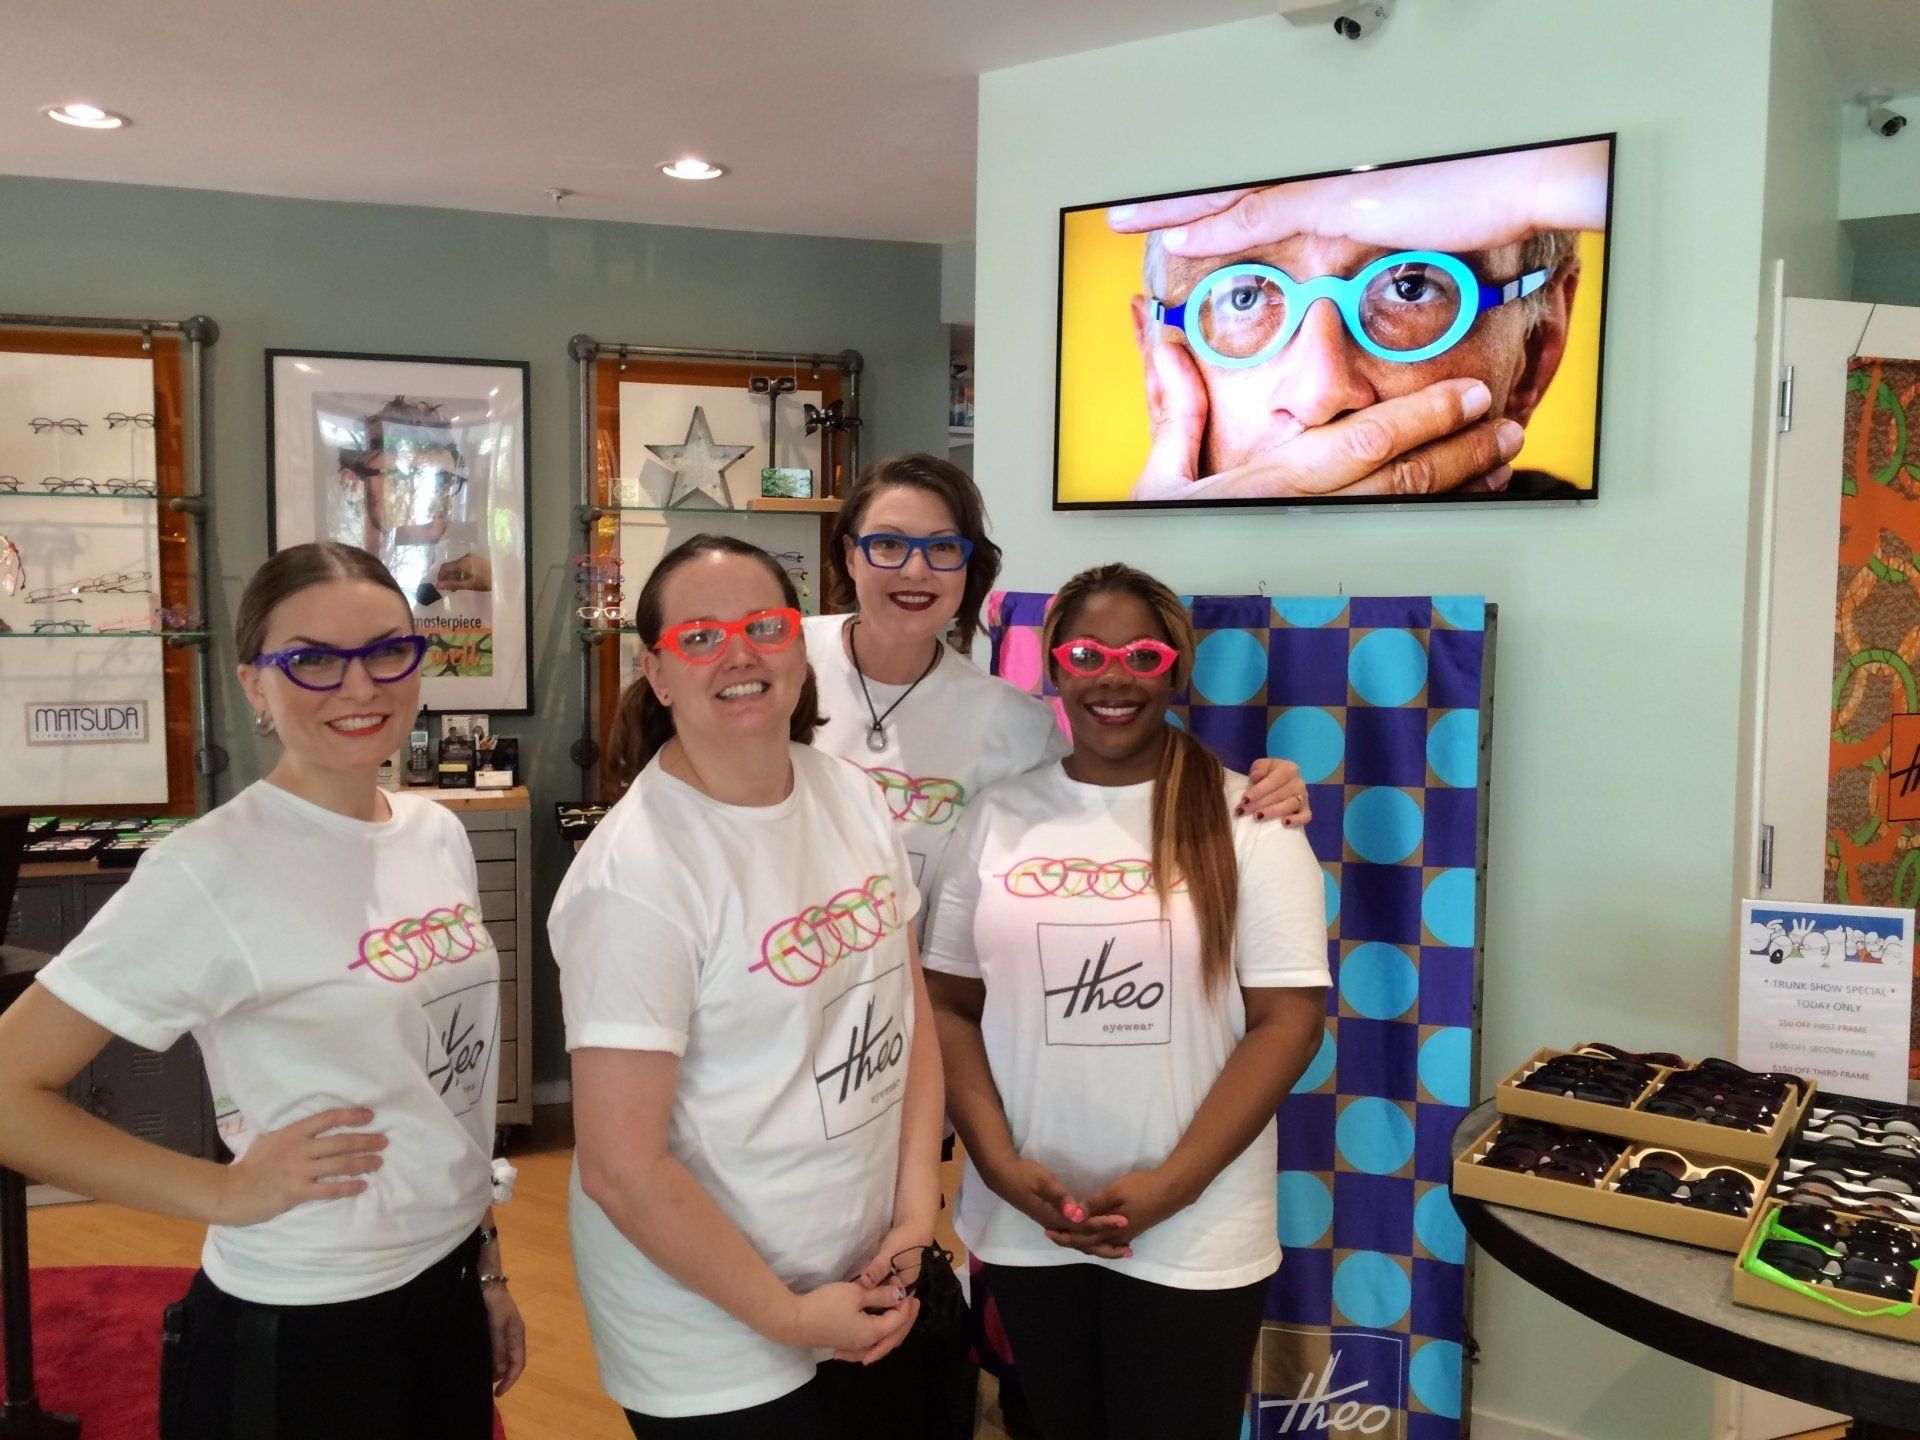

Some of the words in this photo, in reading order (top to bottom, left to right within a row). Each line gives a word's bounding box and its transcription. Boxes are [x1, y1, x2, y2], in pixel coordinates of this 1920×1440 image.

[413, 615, 482, 631] masterpiece
[35, 707, 139, 732] MATSUDA
[1045, 936, 1164, 1019] theo
[1772, 979, 1807, 991] TRUNK
[1810, 982, 1843, 994] SHOW
[1846, 985, 1888, 997] SPECIAL
[1796, 1000, 1830, 1011] TODAY
[1834, 1002, 1862, 1013] ONLY
[1102, 1022, 1154, 1034] eyewear
[1795, 1020, 1811, 1029] OFF
[1813, 1022, 1836, 1031] FIRST
[1838, 1024, 1869, 1034] FRAME
[816, 994, 903, 1104] theo
[1845, 1048, 1876, 1058] FRAME
[1772, 1064, 1793, 1073] $150
[1795, 1066, 1811, 1075] OFF
[1812, 1068, 1839, 1078] THIRD
[1840, 1071, 1871, 1081] FRAME
[1259, 1349, 1392, 1434] theo
